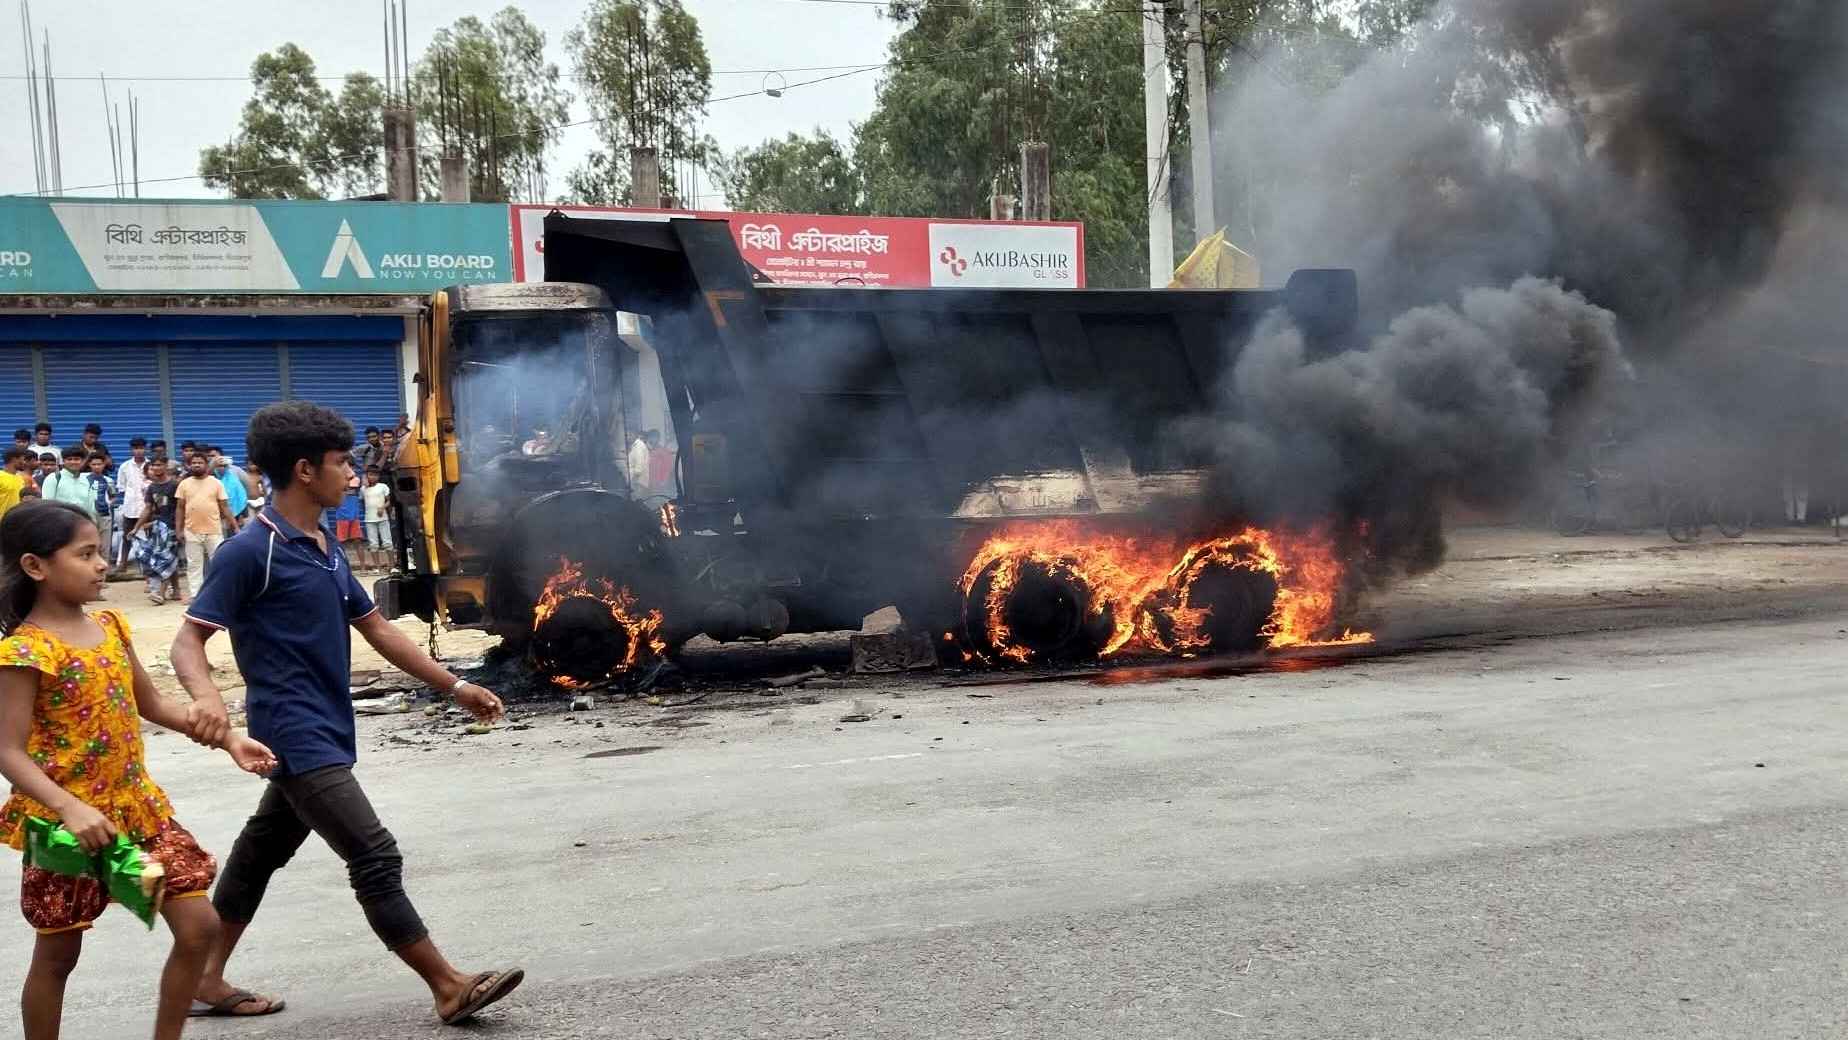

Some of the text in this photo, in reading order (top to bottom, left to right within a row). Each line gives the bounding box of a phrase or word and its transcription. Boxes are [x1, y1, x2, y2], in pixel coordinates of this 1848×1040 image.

[105, 223, 248, 246] বিথি এন্টারপ্রাইজ
[741, 223, 889, 255] বিথী এন্টারপ্রাইজ
[380, 254, 495, 269] AKIJ BOARD
[380, 270, 496, 279] NOW YOU CAN
[1033, 269, 1069, 279] GLSS
